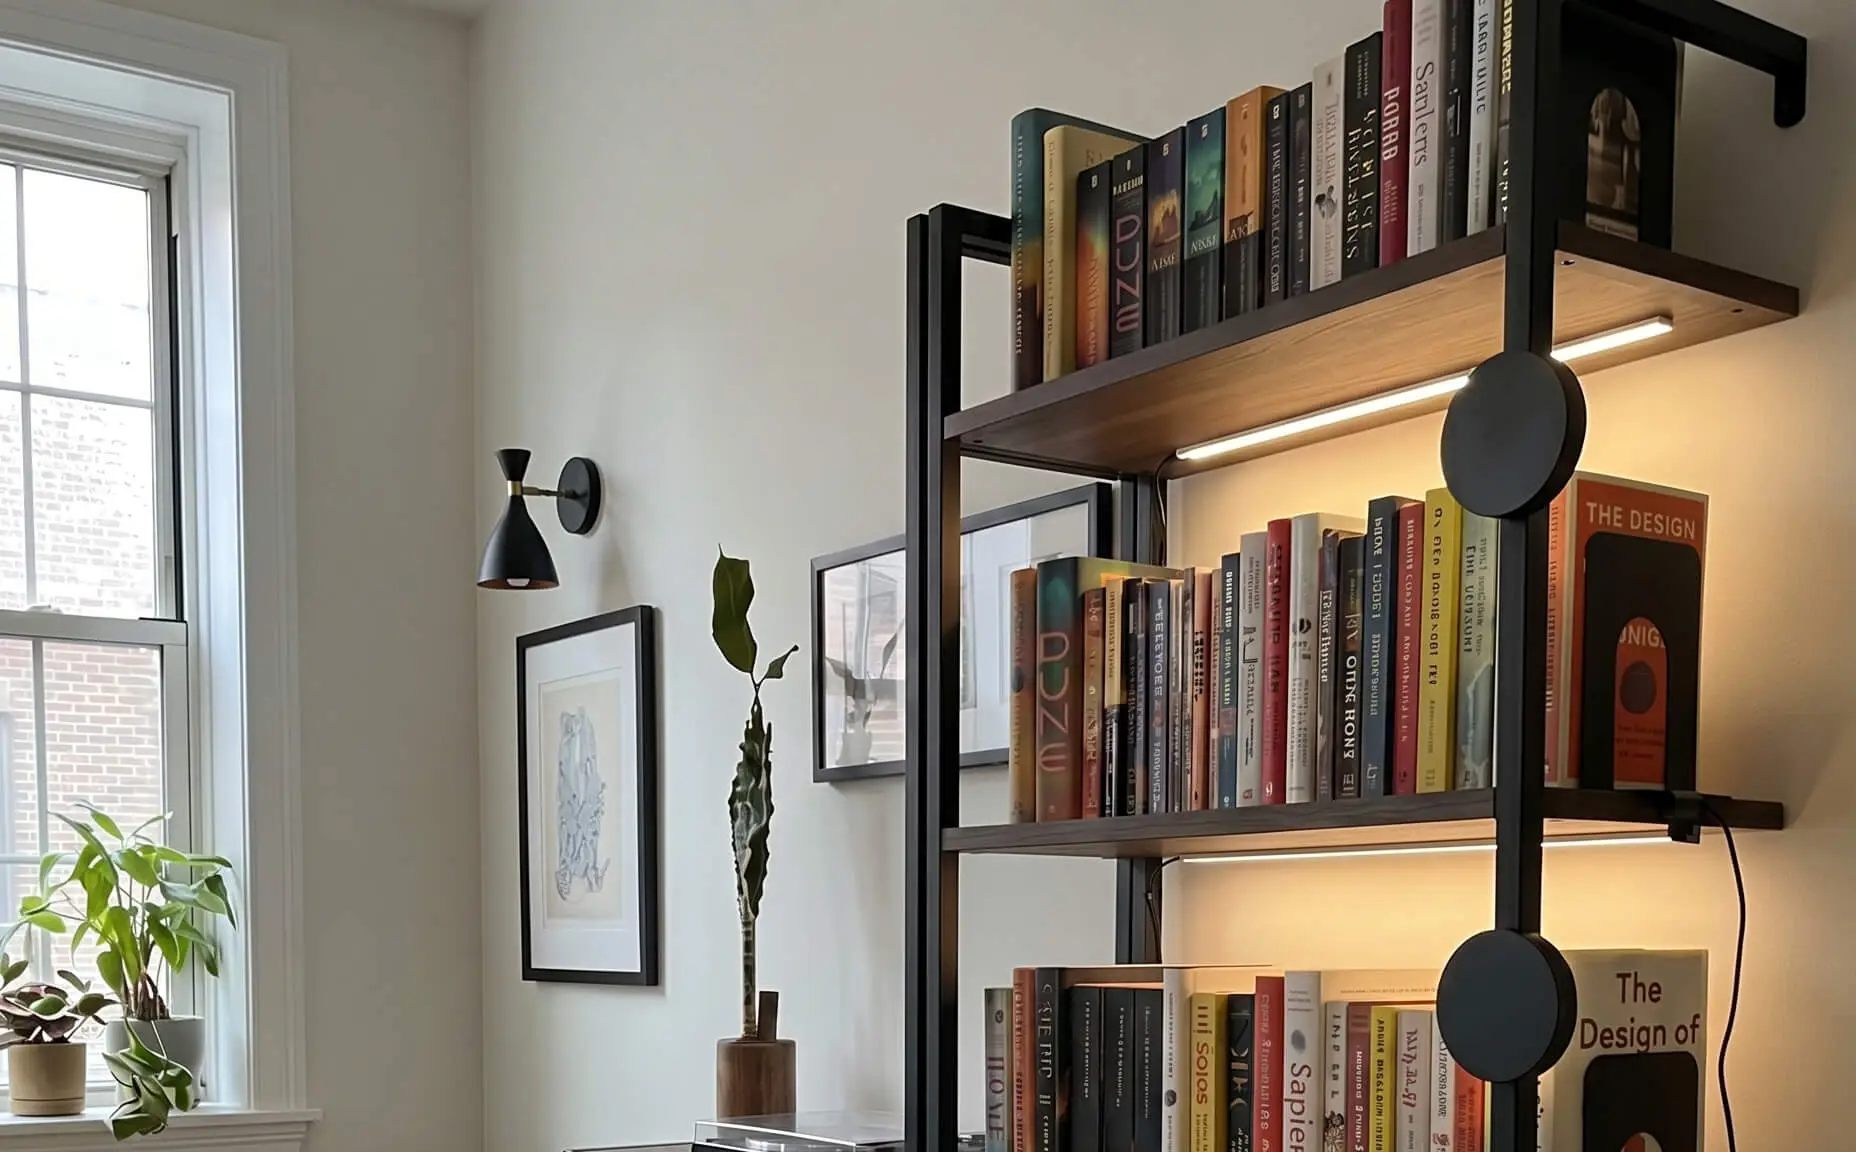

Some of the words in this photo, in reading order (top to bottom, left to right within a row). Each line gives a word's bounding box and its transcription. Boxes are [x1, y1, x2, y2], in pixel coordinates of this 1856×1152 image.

[1116, 214, 1141, 333] DUNE
[1586, 502, 1622, 528] THE
[1630, 509, 1696, 540] DESIGN
[1039, 632, 1070, 772] DUNE
[1616, 972, 1662, 1003] The
[1580, 1017, 1667, 1053] Design
[1675, 1013, 1700, 1045] of
